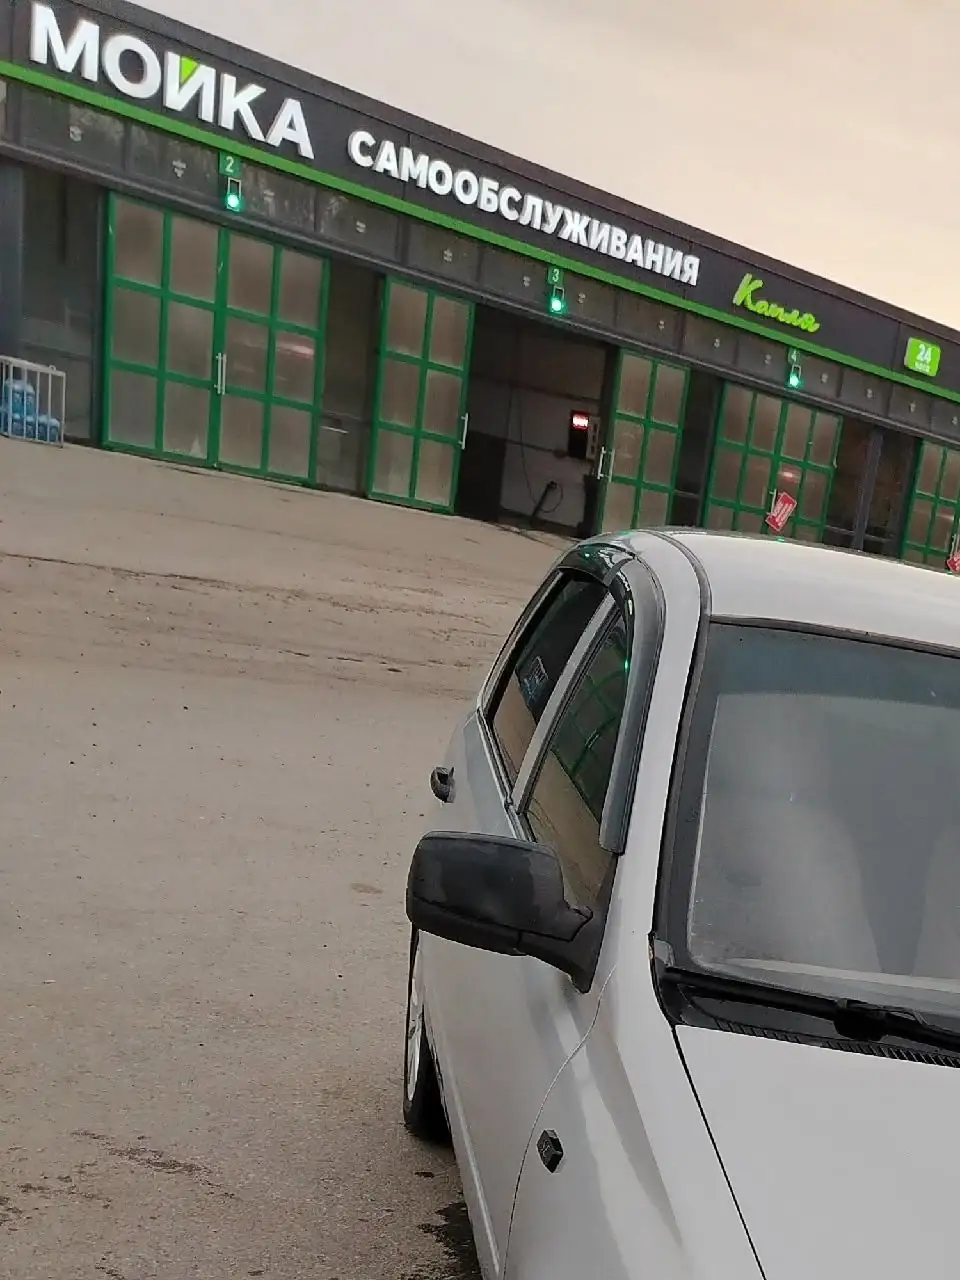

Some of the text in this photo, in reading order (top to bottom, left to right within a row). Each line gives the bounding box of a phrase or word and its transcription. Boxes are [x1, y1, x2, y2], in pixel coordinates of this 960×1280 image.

[225, 155, 235, 173] 2
[348, 130, 700, 286] САМООБСЛУЖИВАНИЯ
[552, 268, 560, 282] 3
[916, 343, 932, 363] 24
